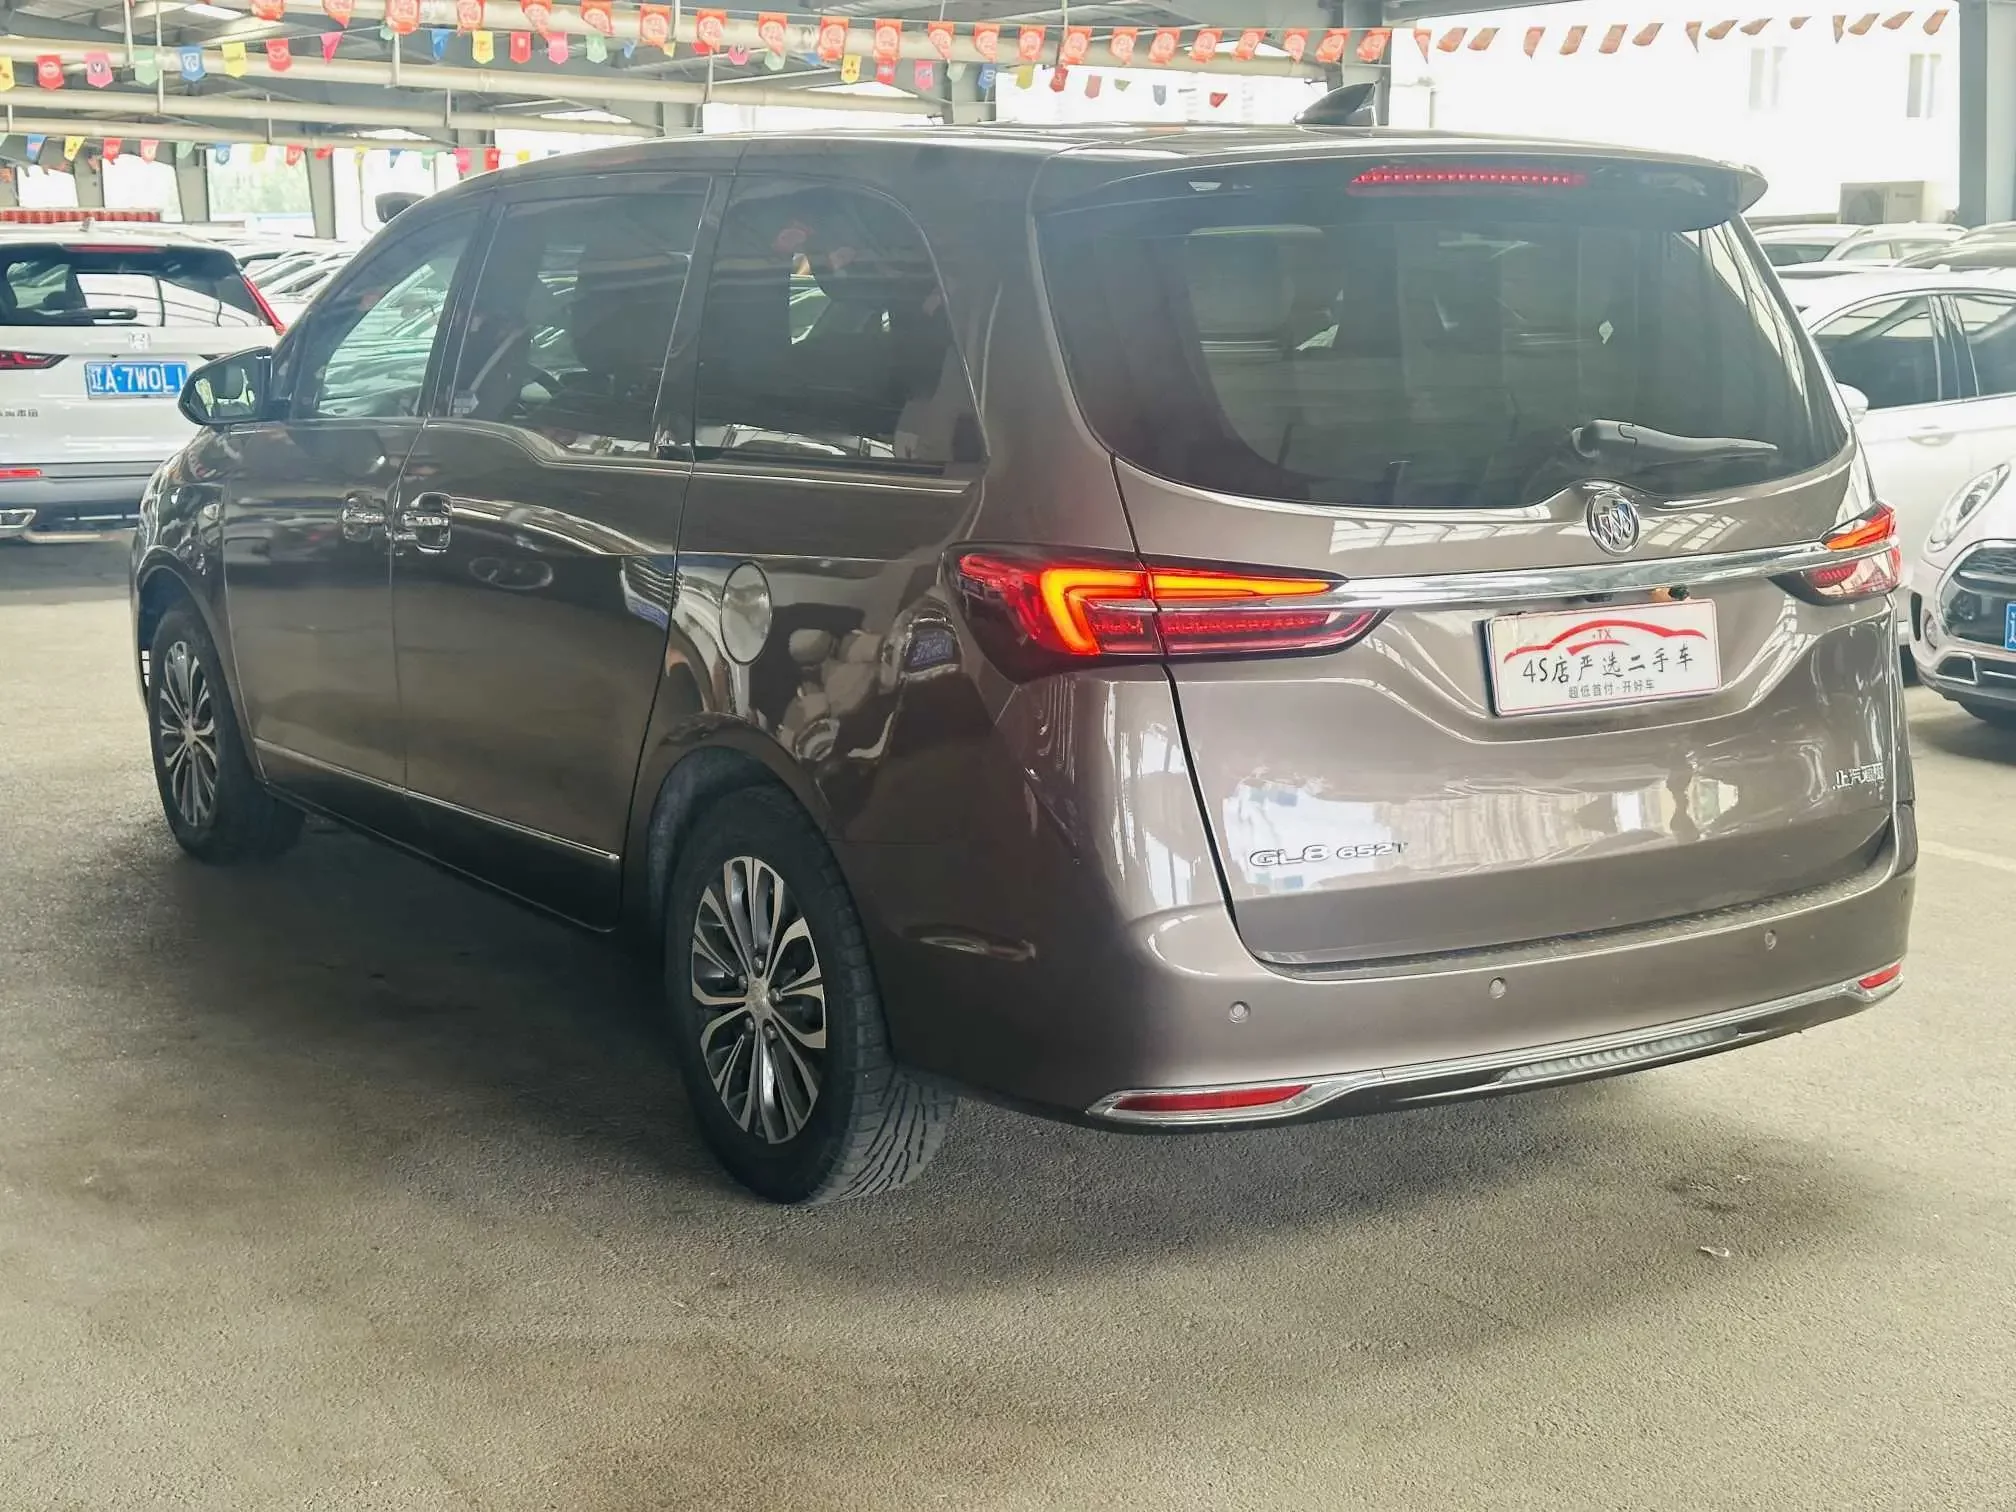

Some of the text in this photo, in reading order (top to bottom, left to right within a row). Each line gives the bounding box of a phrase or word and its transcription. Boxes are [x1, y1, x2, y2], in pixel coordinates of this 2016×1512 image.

[1522, 641, 1694, 683] 4S店严选二手车
[1249, 842, 1409, 867] GL8 652T
